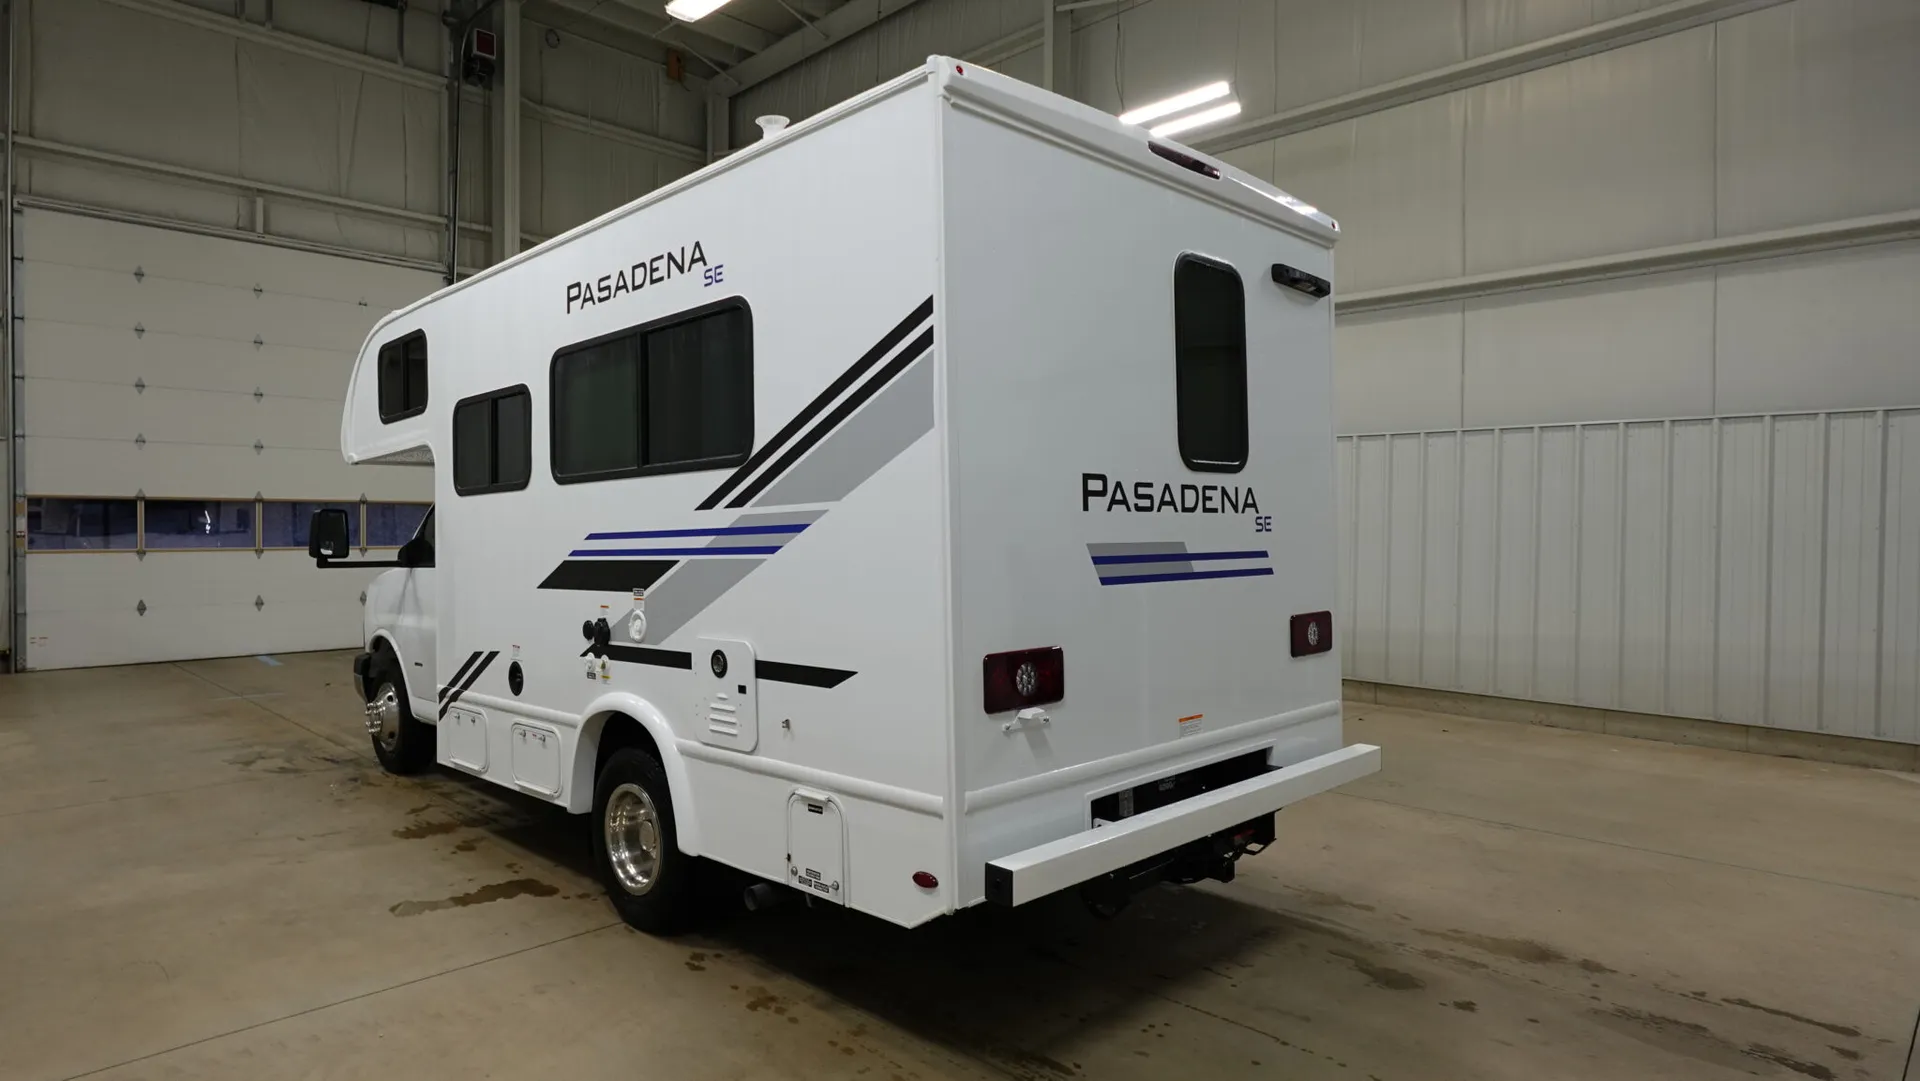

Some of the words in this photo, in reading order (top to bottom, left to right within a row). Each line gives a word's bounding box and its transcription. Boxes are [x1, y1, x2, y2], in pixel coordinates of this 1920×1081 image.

[566, 240, 708, 314] PASADENA
[703, 264, 724, 287] SE
[1081, 473, 1260, 514] PASADENA
[1255, 516, 1272, 532] SE
